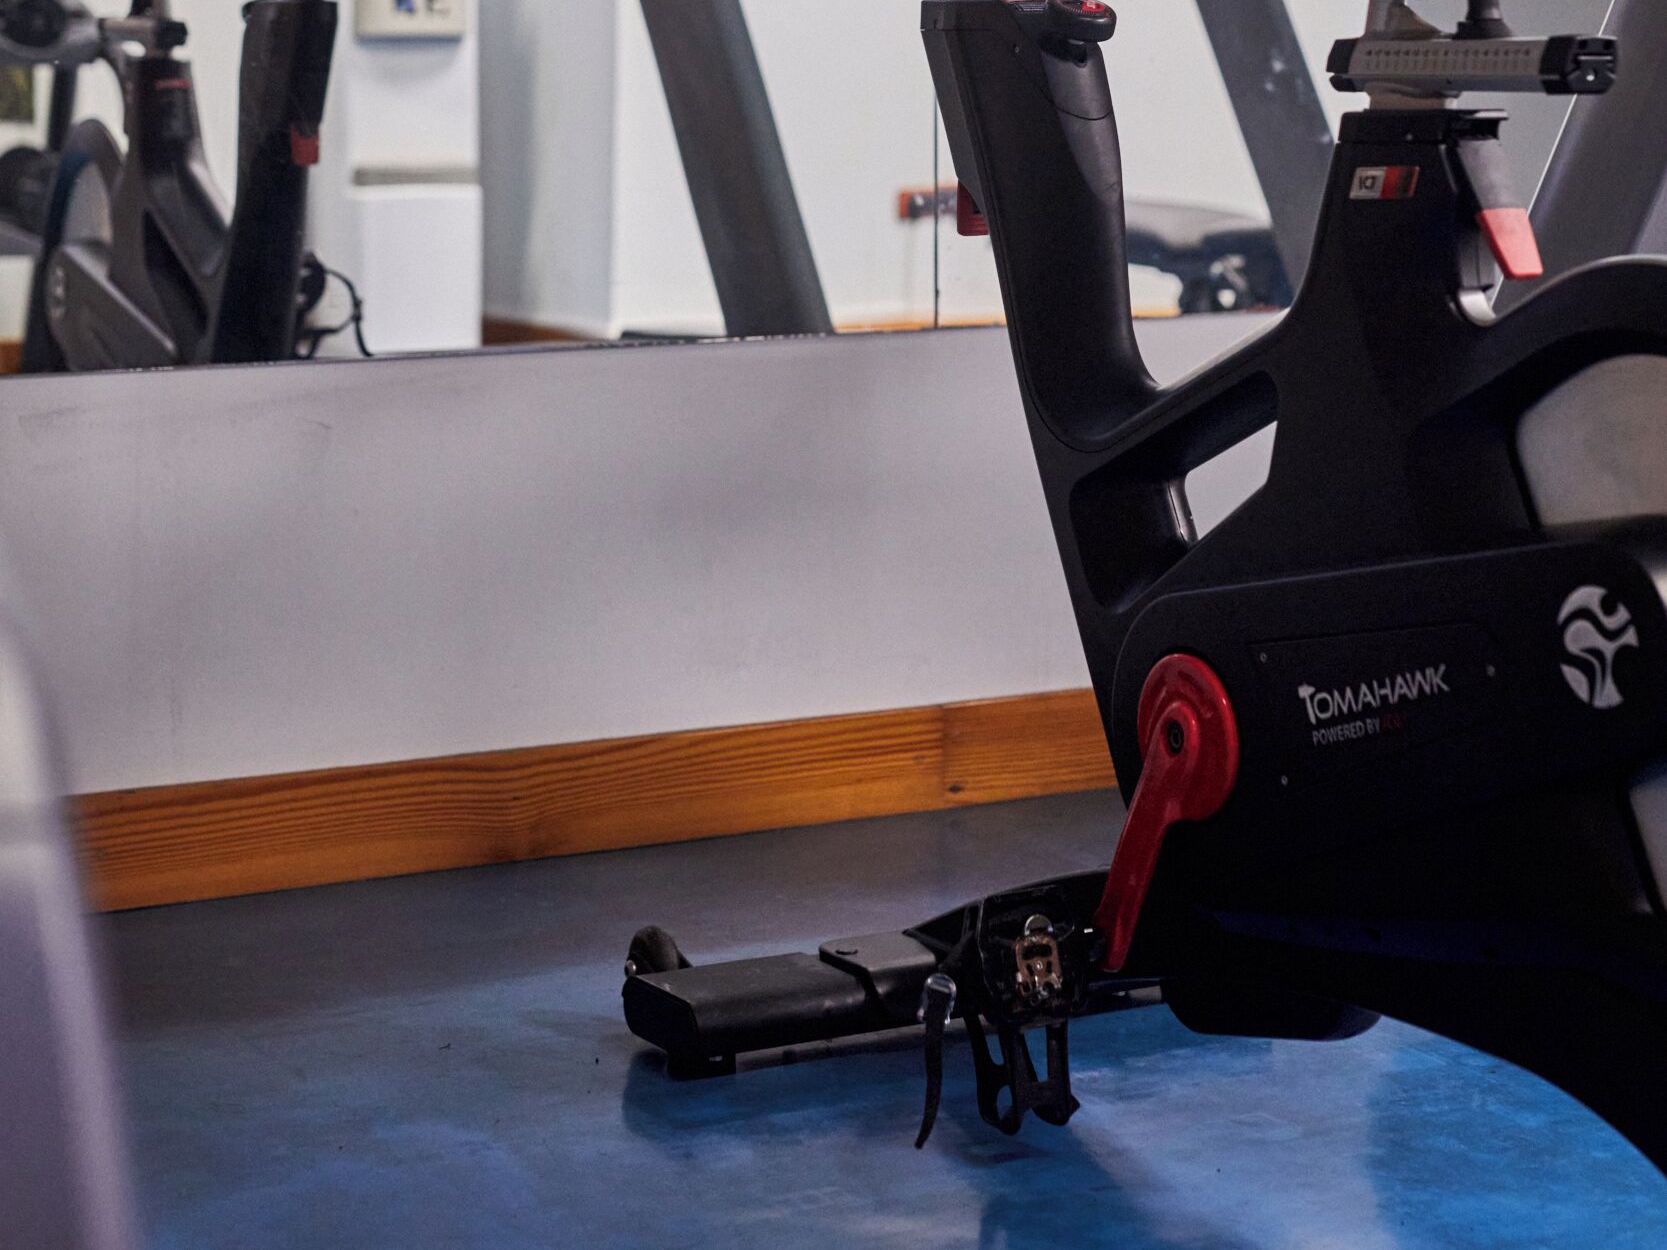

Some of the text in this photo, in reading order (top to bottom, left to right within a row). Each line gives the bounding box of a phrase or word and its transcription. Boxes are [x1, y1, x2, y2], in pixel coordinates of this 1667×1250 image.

[1297, 662, 1450, 726] TOMAHAWK
[1312, 720, 1366, 747] POWERED
[1366, 717, 1381, 734] BY
